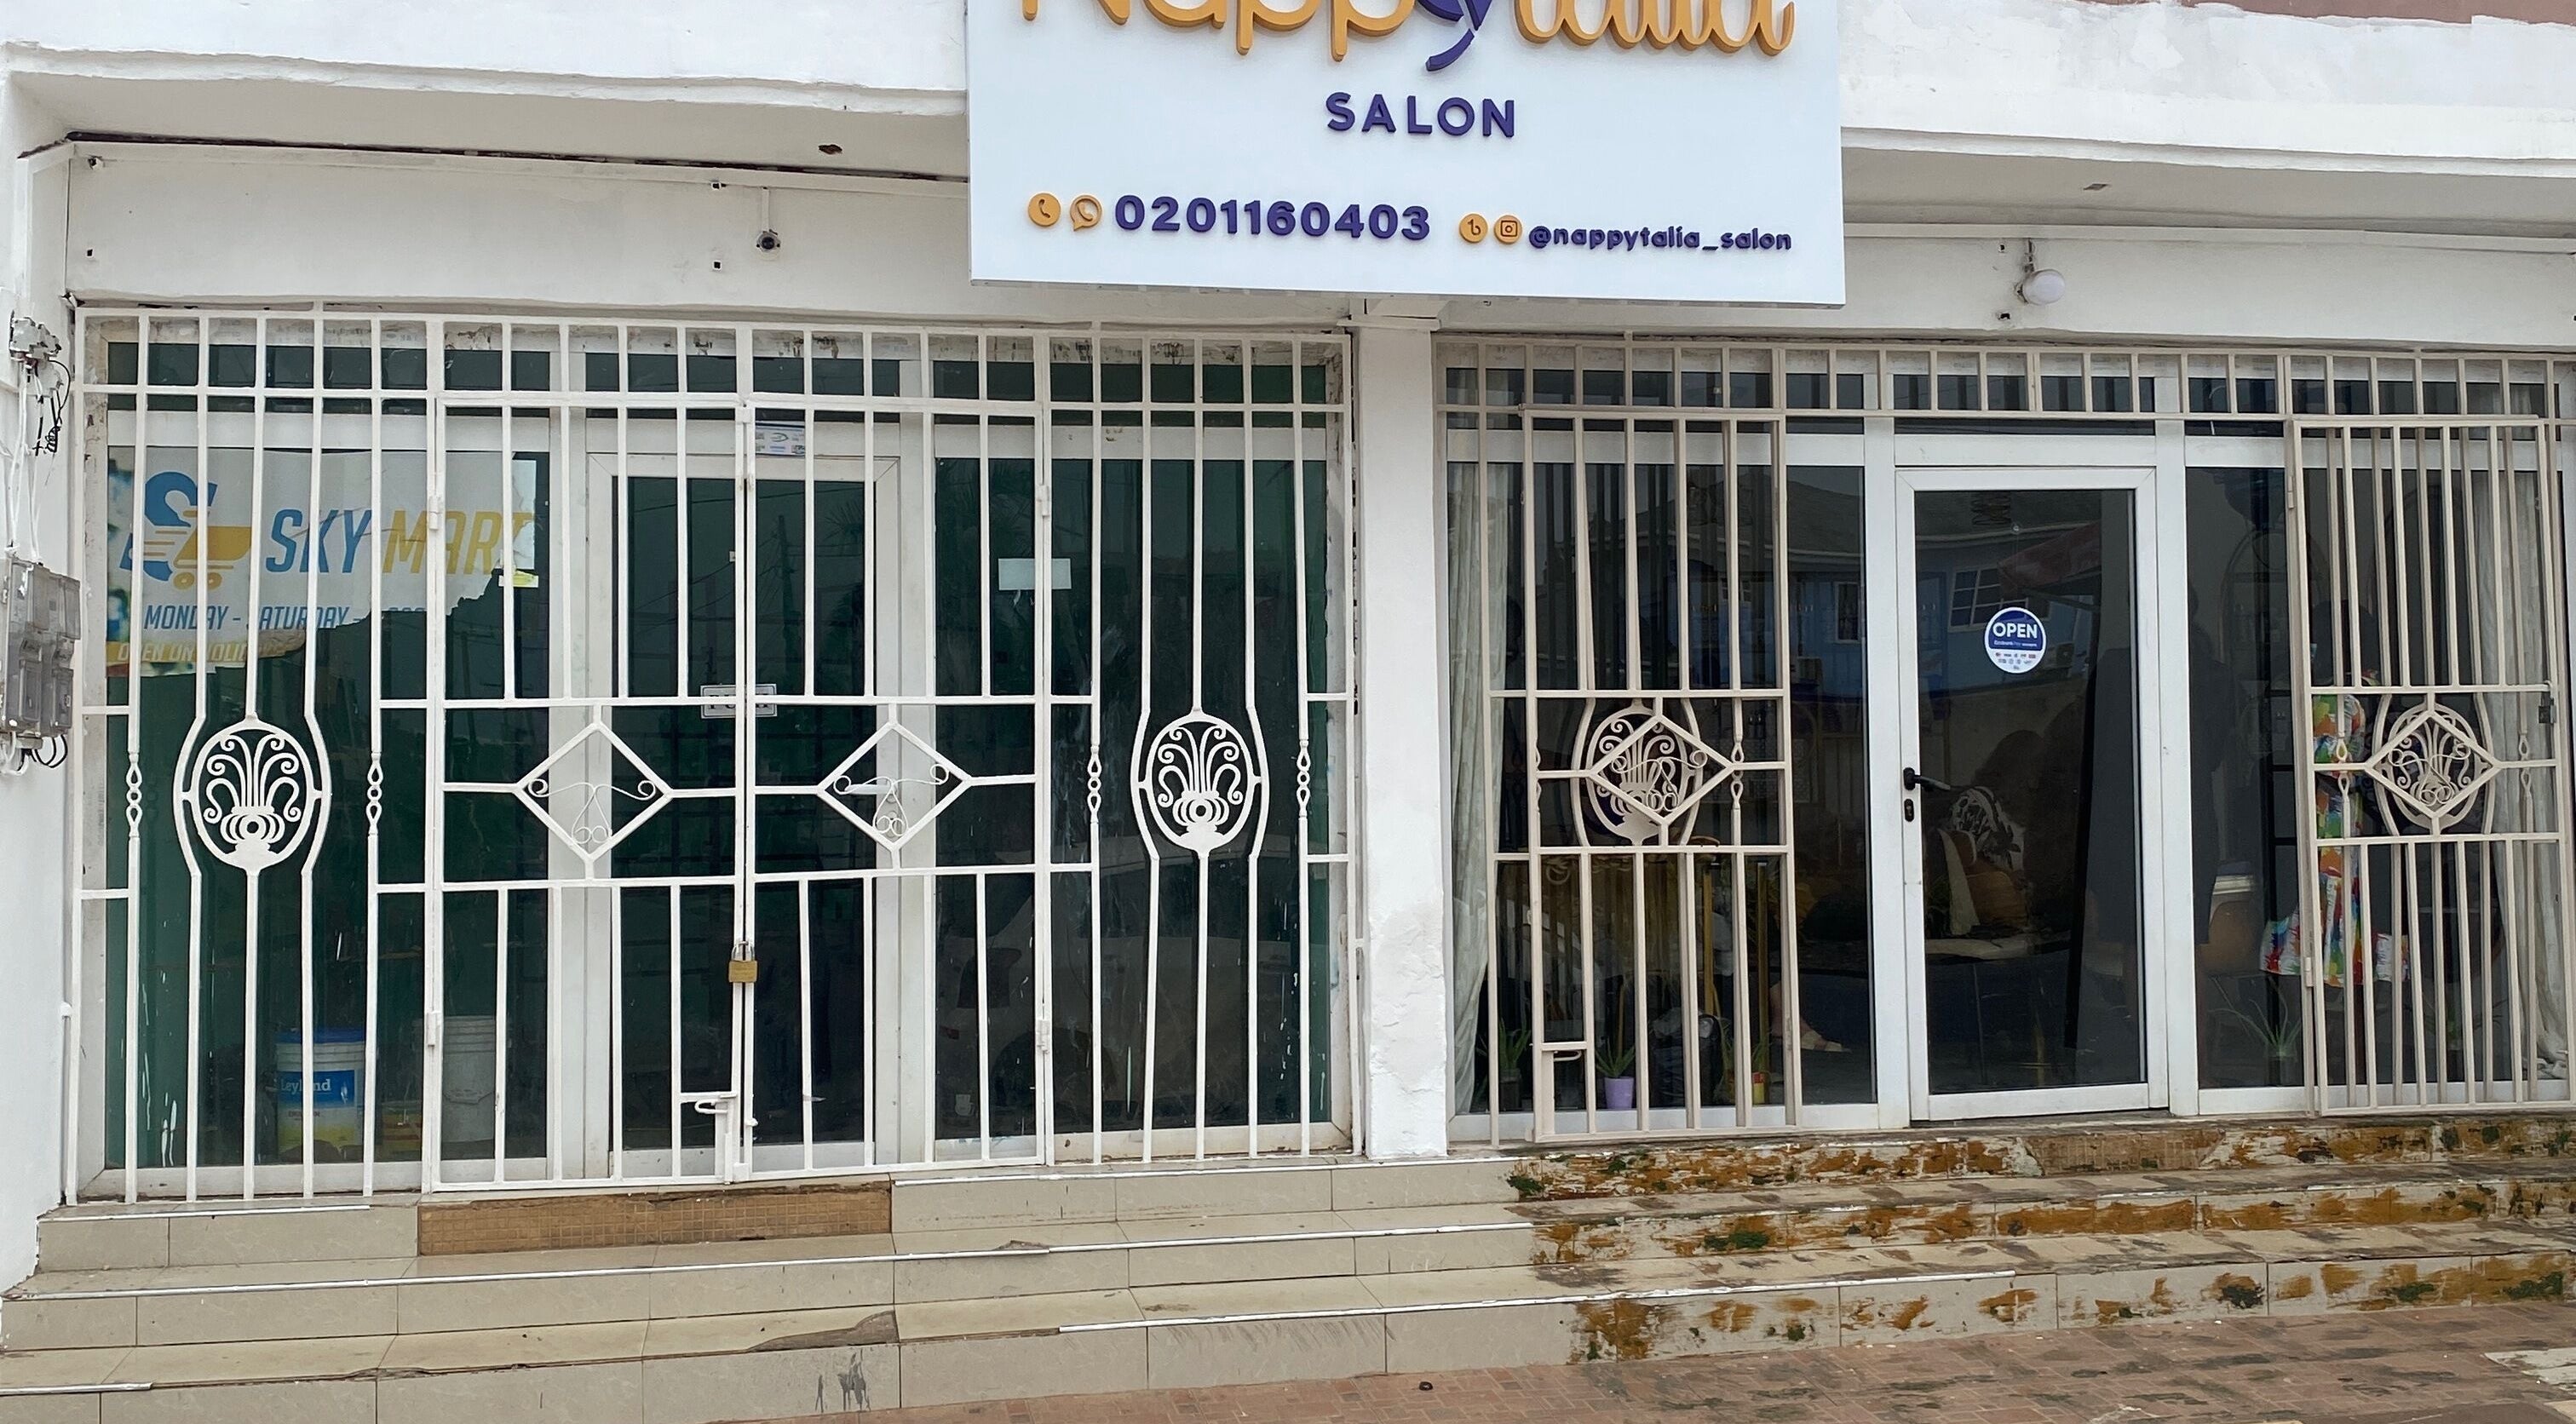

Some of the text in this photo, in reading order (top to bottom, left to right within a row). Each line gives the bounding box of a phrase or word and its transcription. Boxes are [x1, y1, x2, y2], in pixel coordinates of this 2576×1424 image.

[1325, 91, 1515, 138] SALON
[1114, 194, 1431, 242] 0201160403
[1528, 225, 1792, 251] @nappytalia_salon
[265, 508, 372, 573] SKY
[143, 605, 229, 629] MONDAY
[245, 606, 350, 630] ATURDAY
[1992, 623, 2038, 639] OPEN
[118, 641, 166, 662] OEN
[280, 1078, 331, 1095] Leylnd
